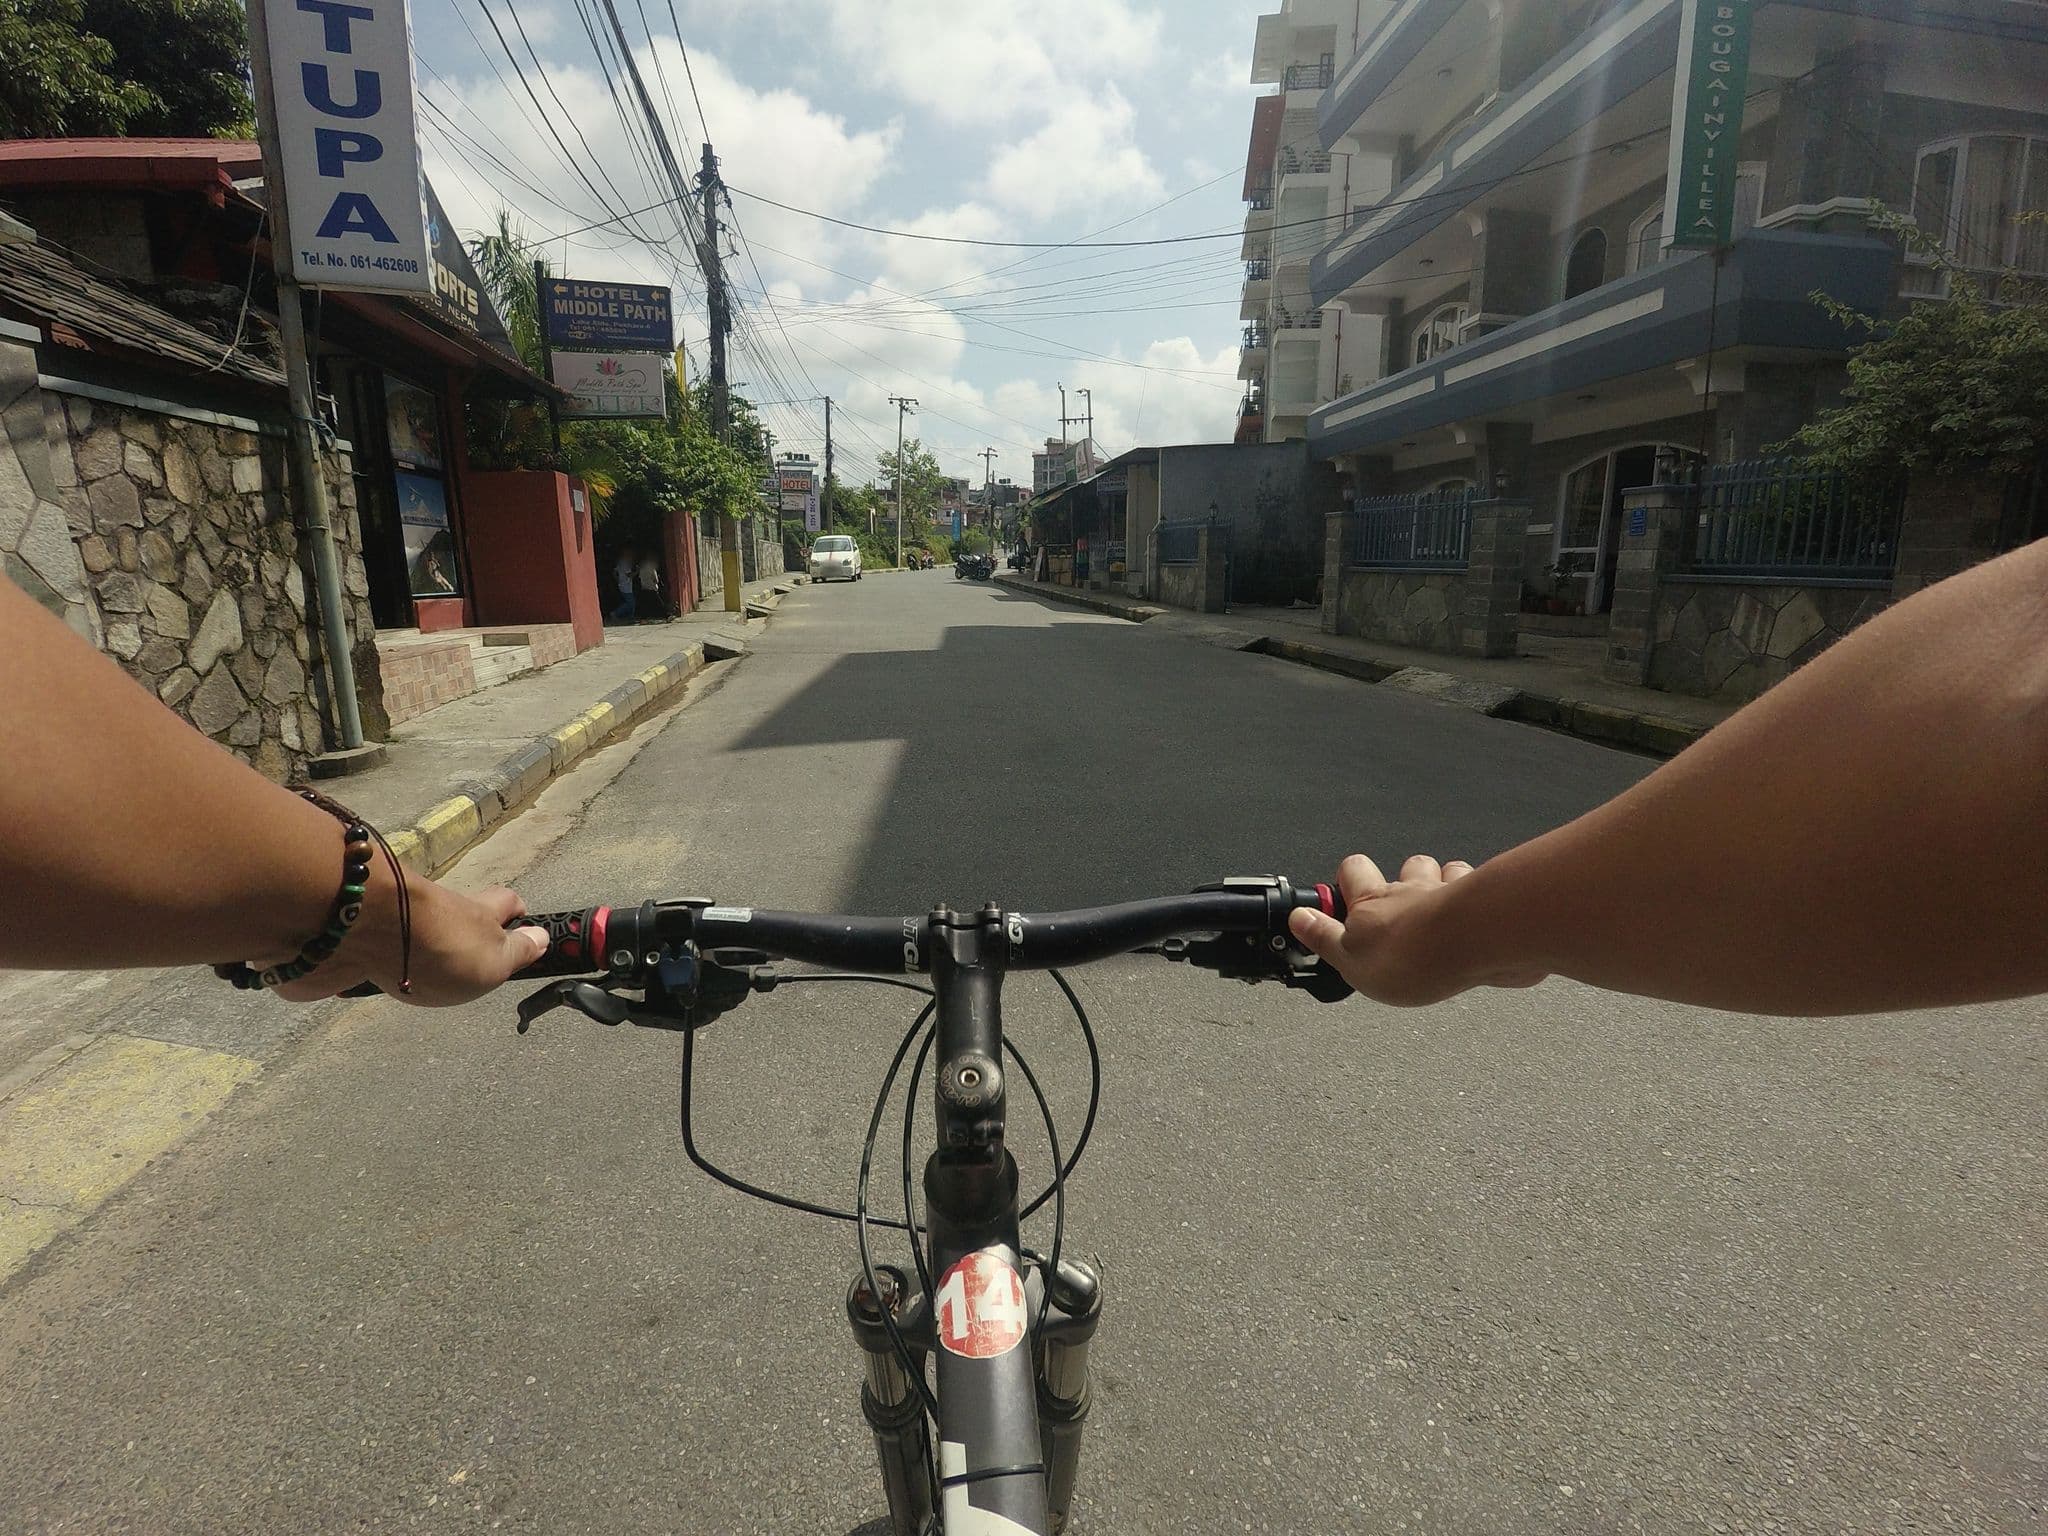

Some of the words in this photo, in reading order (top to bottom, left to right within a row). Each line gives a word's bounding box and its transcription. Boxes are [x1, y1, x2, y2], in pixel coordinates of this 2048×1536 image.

[296, 0, 400, 244] TUPA
[1694, 6, 1736, 229] BOUGAINVILLEA
[301, 251, 324, 266] Tel.
[327, 253, 348, 267] No.
[350, 254, 419, 274] 061-462608
[573, 285, 644, 302] HOTEL
[447, 303, 480, 333] NEPAL
[553, 299, 620, 319] MIDDLE
[623, 303, 667, 322] PATH
[782, 479, 811, 490] HOTEL
[937, 1267, 1024, 1341] 14
